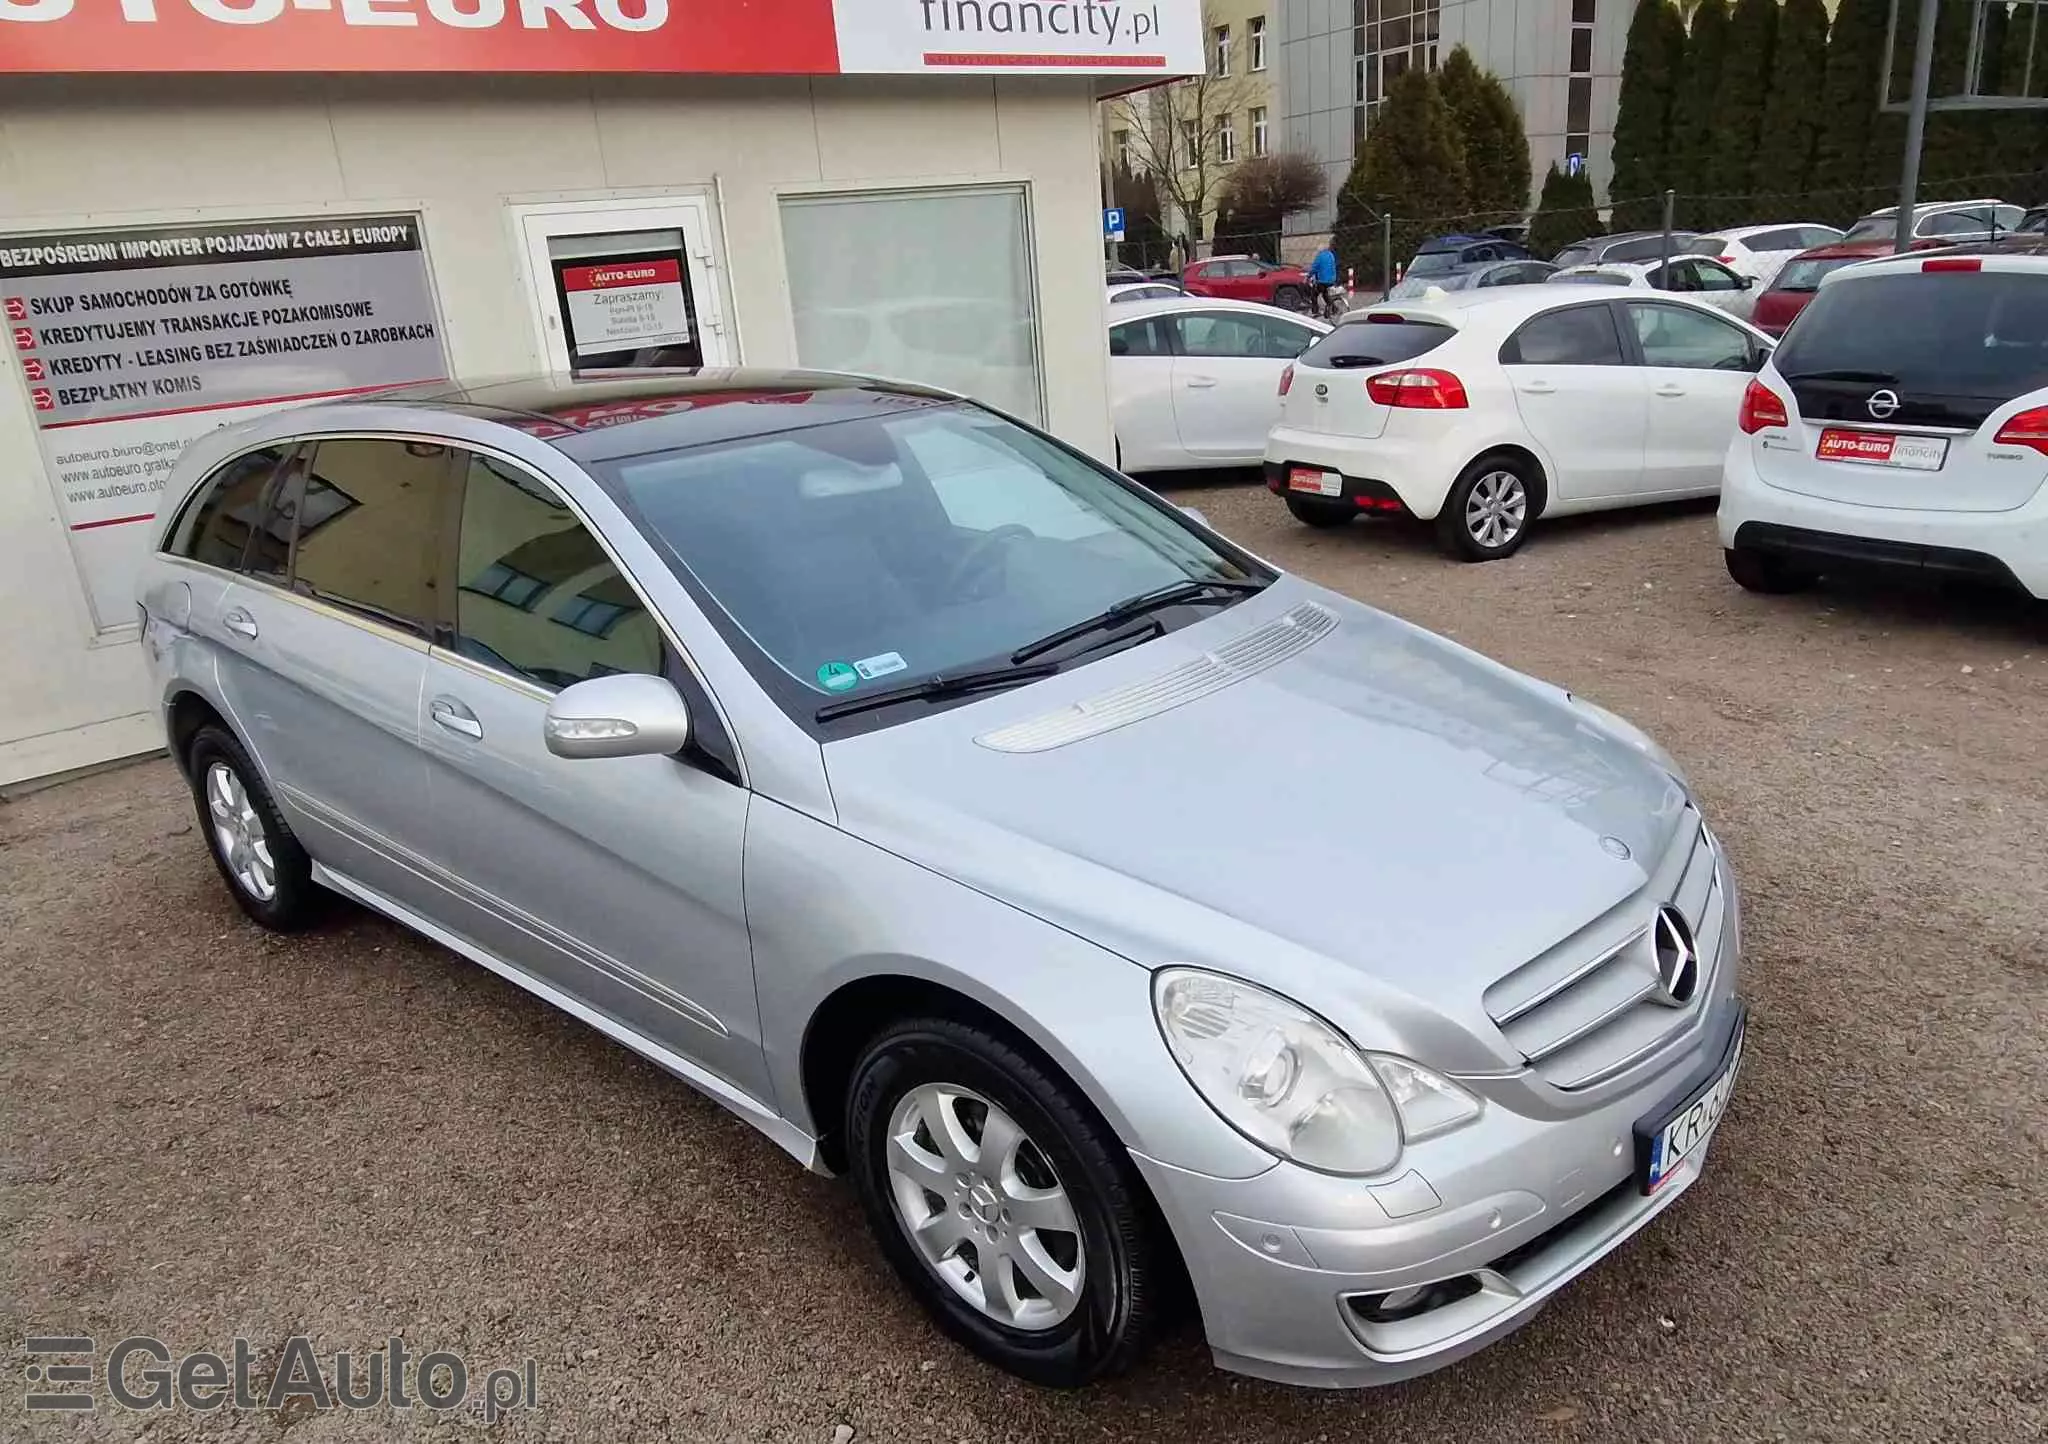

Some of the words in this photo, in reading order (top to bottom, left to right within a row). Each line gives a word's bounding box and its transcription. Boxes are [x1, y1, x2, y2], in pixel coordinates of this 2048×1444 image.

[1108, 211, 1119, 229] P
[0, 241, 117, 267] BEZPOŚREDNI
[120, 238, 204, 260] IMPORTER
[205, 229, 288, 253] POJAZDÓW
[290, 231, 303, 248] Z
[304, 228, 350, 247] CAŁEJ
[353, 225, 408, 244] EUROPY
[595, 269, 656, 281] AUTO-EURO
[30, 295, 75, 315] SKUP
[80, 285, 192, 311] SAMOCHODÓW
[194, 284, 217, 302] ZA
[220, 277, 293, 300] GOTÓWKĘ
[40, 320, 156, 345] KREDYTUJEMY
[161, 310, 259, 335] TRANSAKCJE
[261, 301, 374, 326] POZAKOMISOWE
[49, 353, 124, 376] KREDYTY
[136, 346, 202, 367] LEASING
[205, 342, 234, 361] BEZ
[238, 330, 337, 357] ZAŚWIADCZEŃ
[341, 331, 351, 346] O
[353, 324, 435, 345] ZAROBKACH
[57, 380, 148, 406] BEZPŁATNY
[152, 375, 202, 396] KOMIS
[56, 438, 192, 465] autoeuro.biuro@onet.p
[1825, 439, 1890, 453] AUTO-EURO
